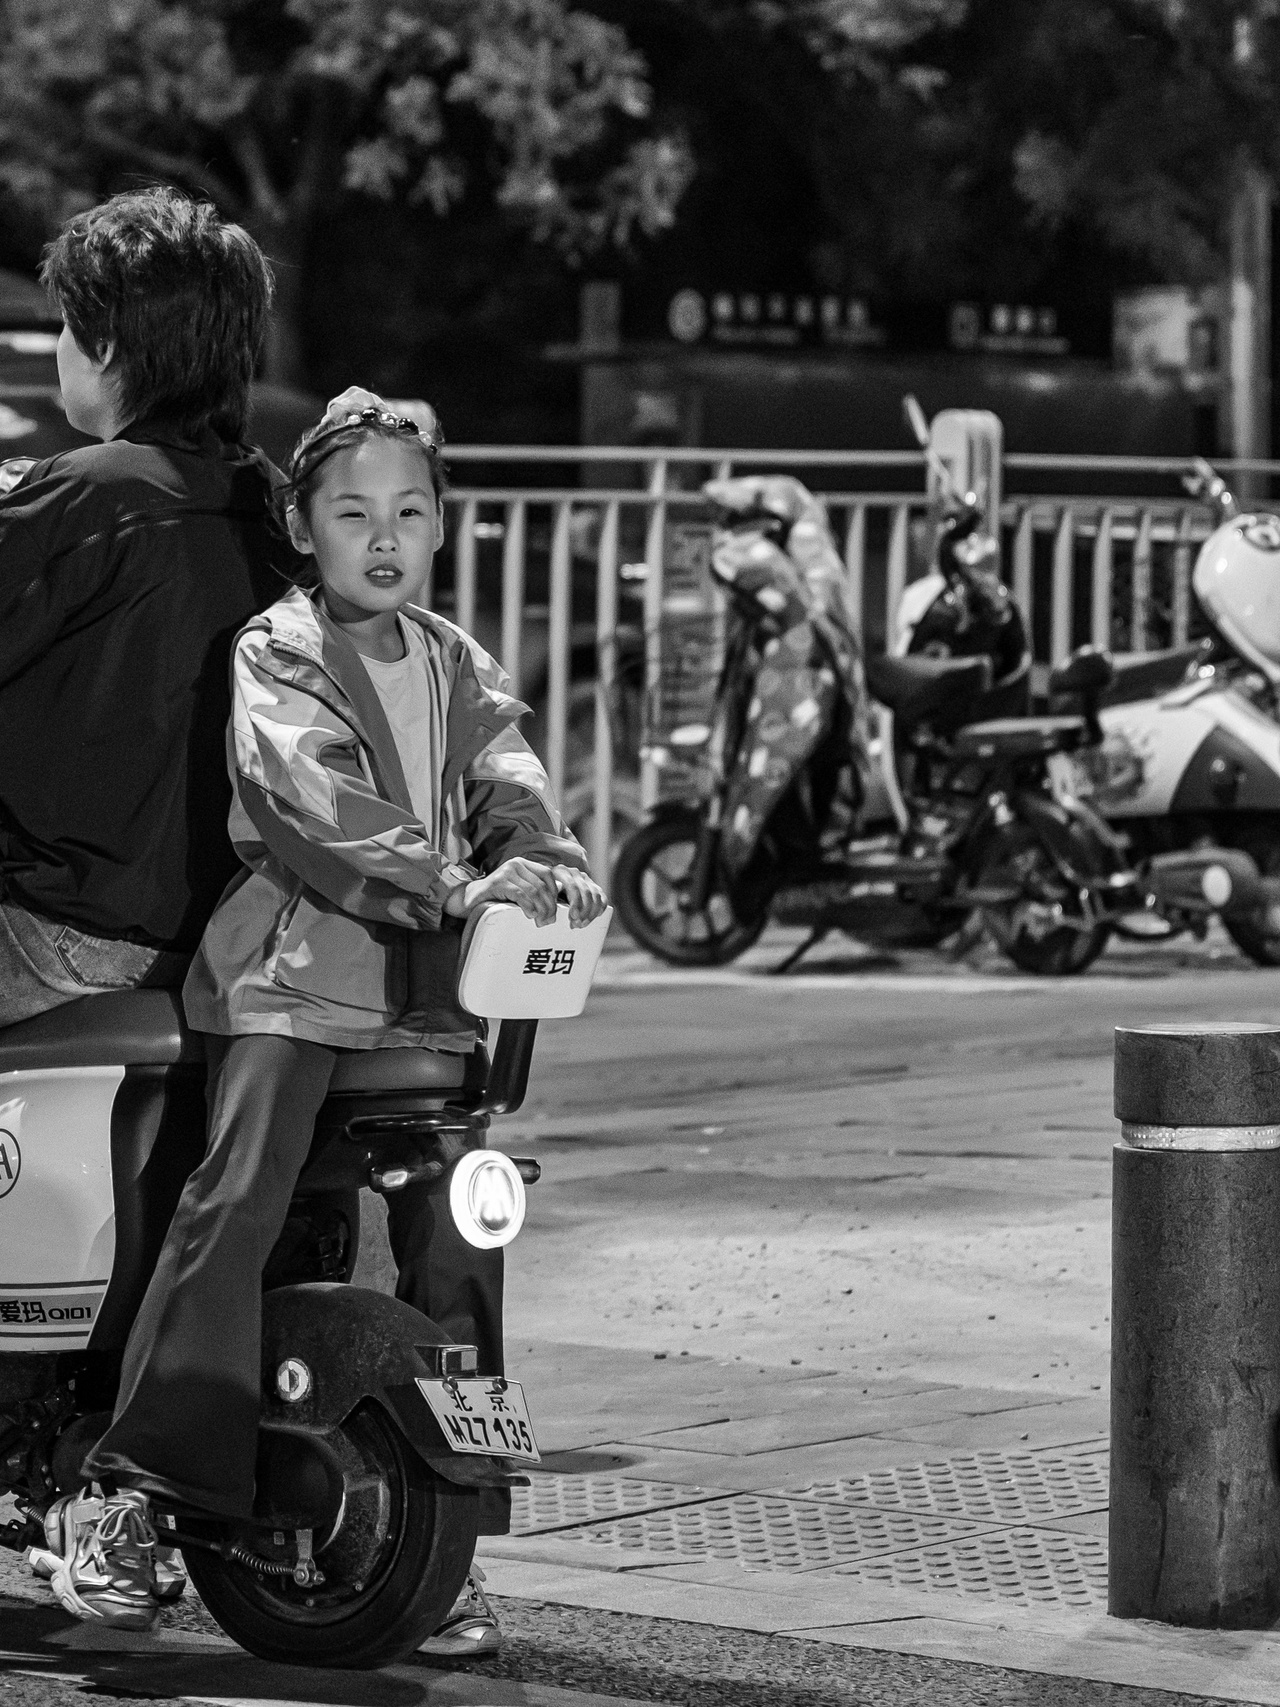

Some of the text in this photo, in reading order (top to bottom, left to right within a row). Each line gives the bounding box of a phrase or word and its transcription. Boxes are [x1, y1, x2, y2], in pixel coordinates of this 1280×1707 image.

[522, 948, 576, 975] 爱玛
[450, 1389, 510, 1412] 北京
[443, 1414, 533, 1453] MZ7135
